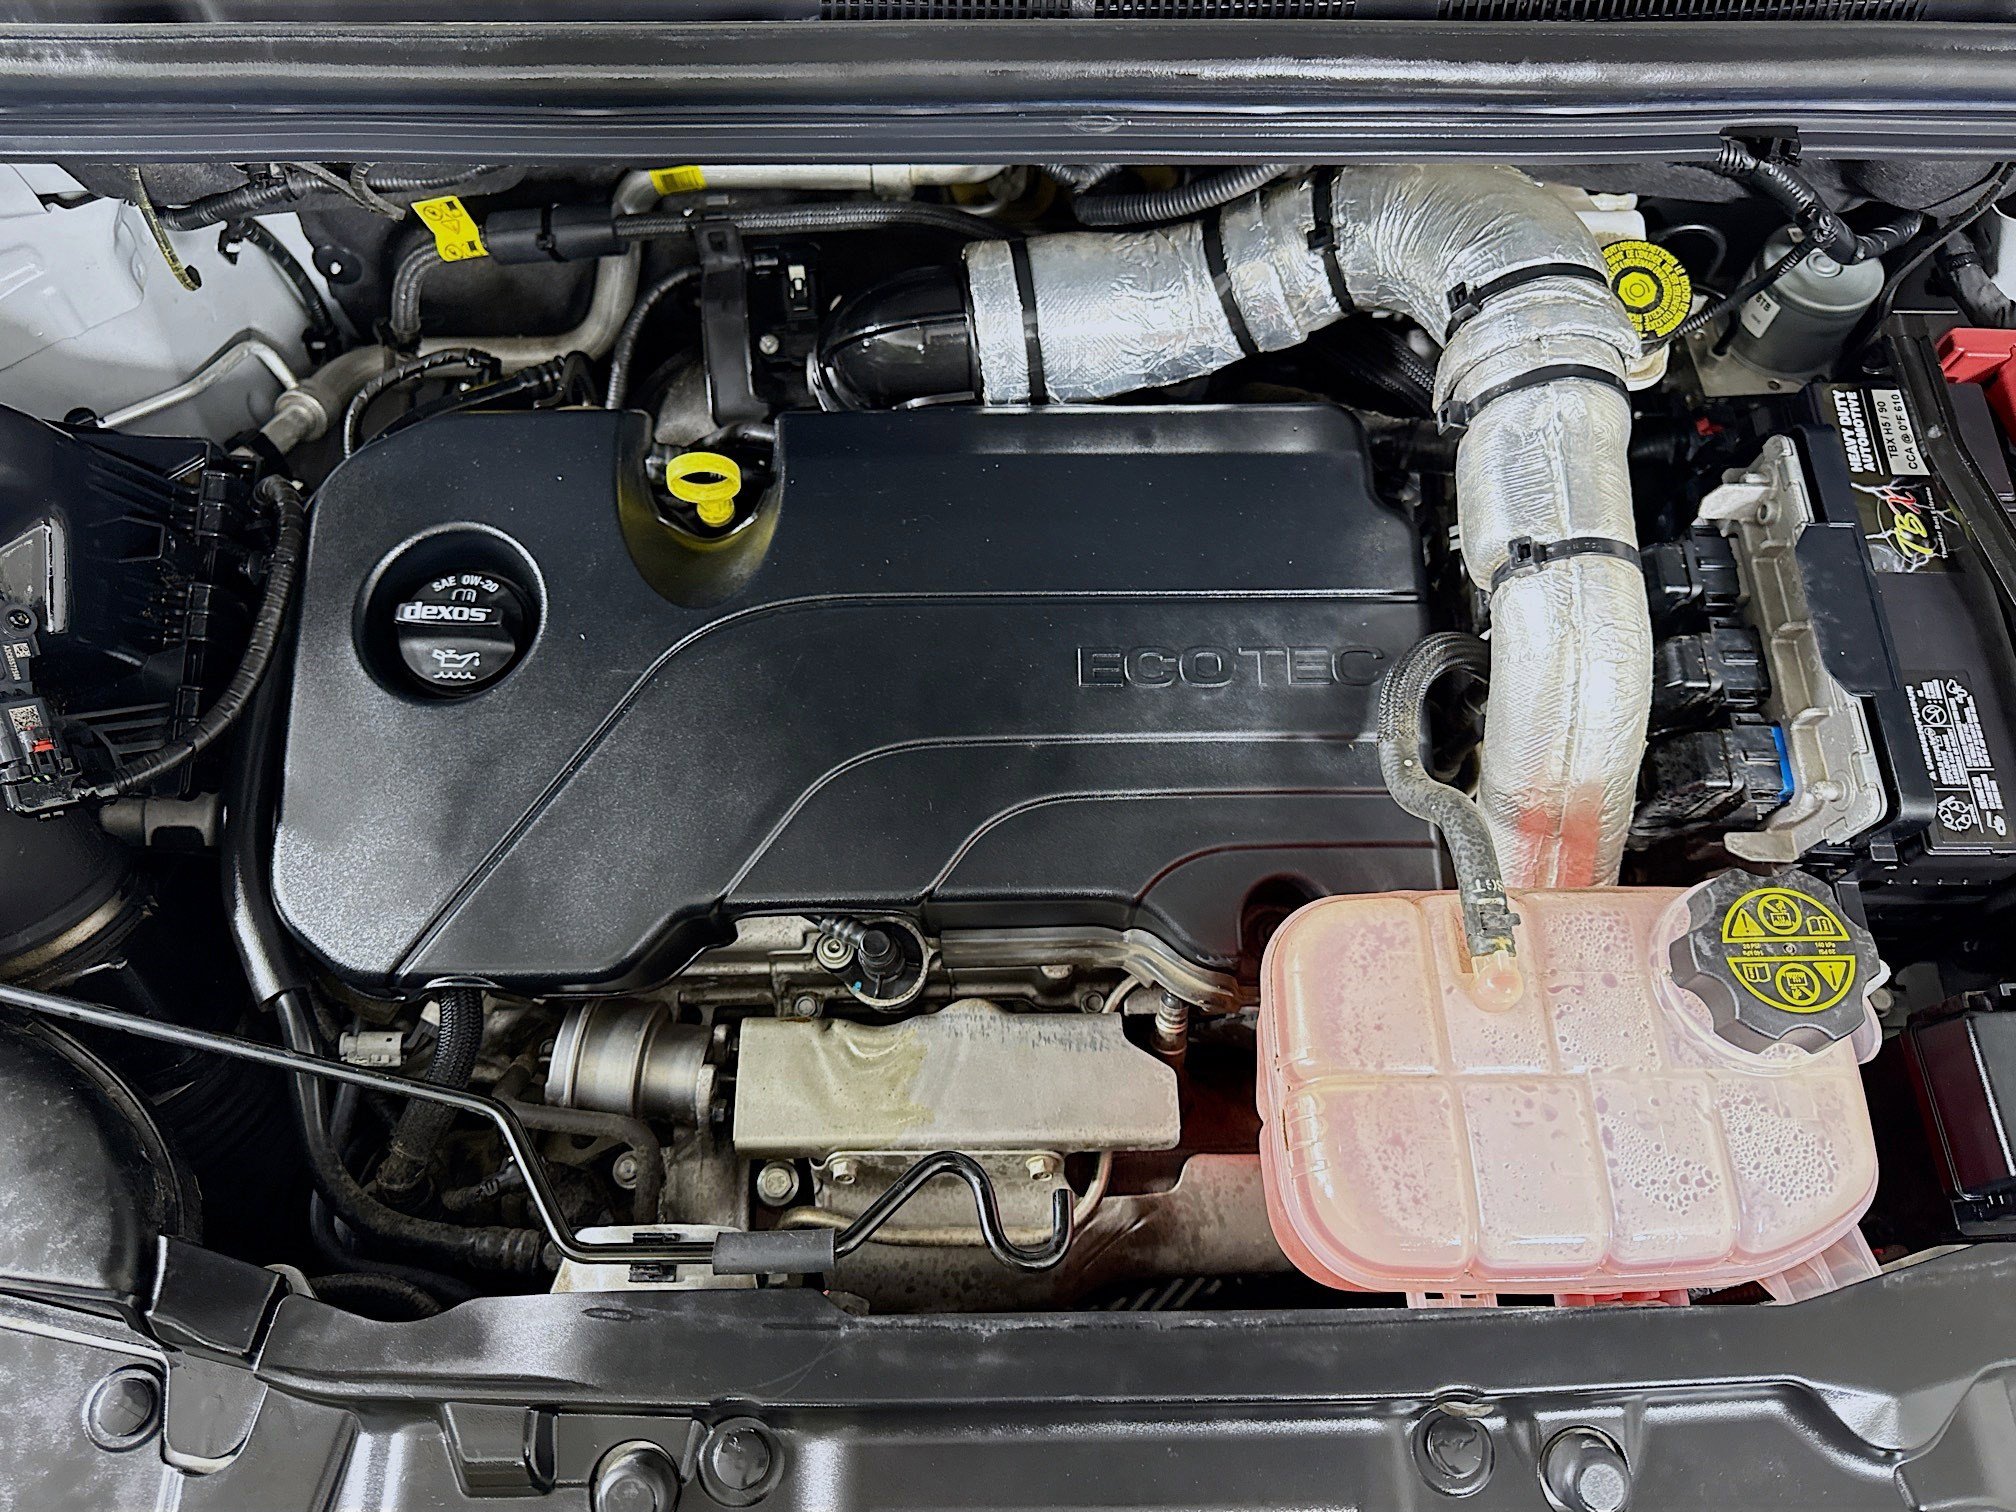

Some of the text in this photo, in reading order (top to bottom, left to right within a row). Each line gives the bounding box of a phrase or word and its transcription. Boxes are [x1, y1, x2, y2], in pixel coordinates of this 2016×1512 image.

[1877, 401, 1887, 413] 90
[1891, 394, 1902, 412] 610
[1832, 389, 1864, 473] HEAVY DUTY
[1846, 391, 1876, 472] AUTOMOTIVE
[1881, 422, 1893, 435] H5
[1901, 433, 1914, 444] @
[1886, 438, 1899, 458] TBX
[1906, 447, 1918, 470] CCA
[432, 574, 499, 593] SAE 0W-20
[403, 601, 490, 622] dexos
[1077, 646, 1385, 688] ECOTEC
